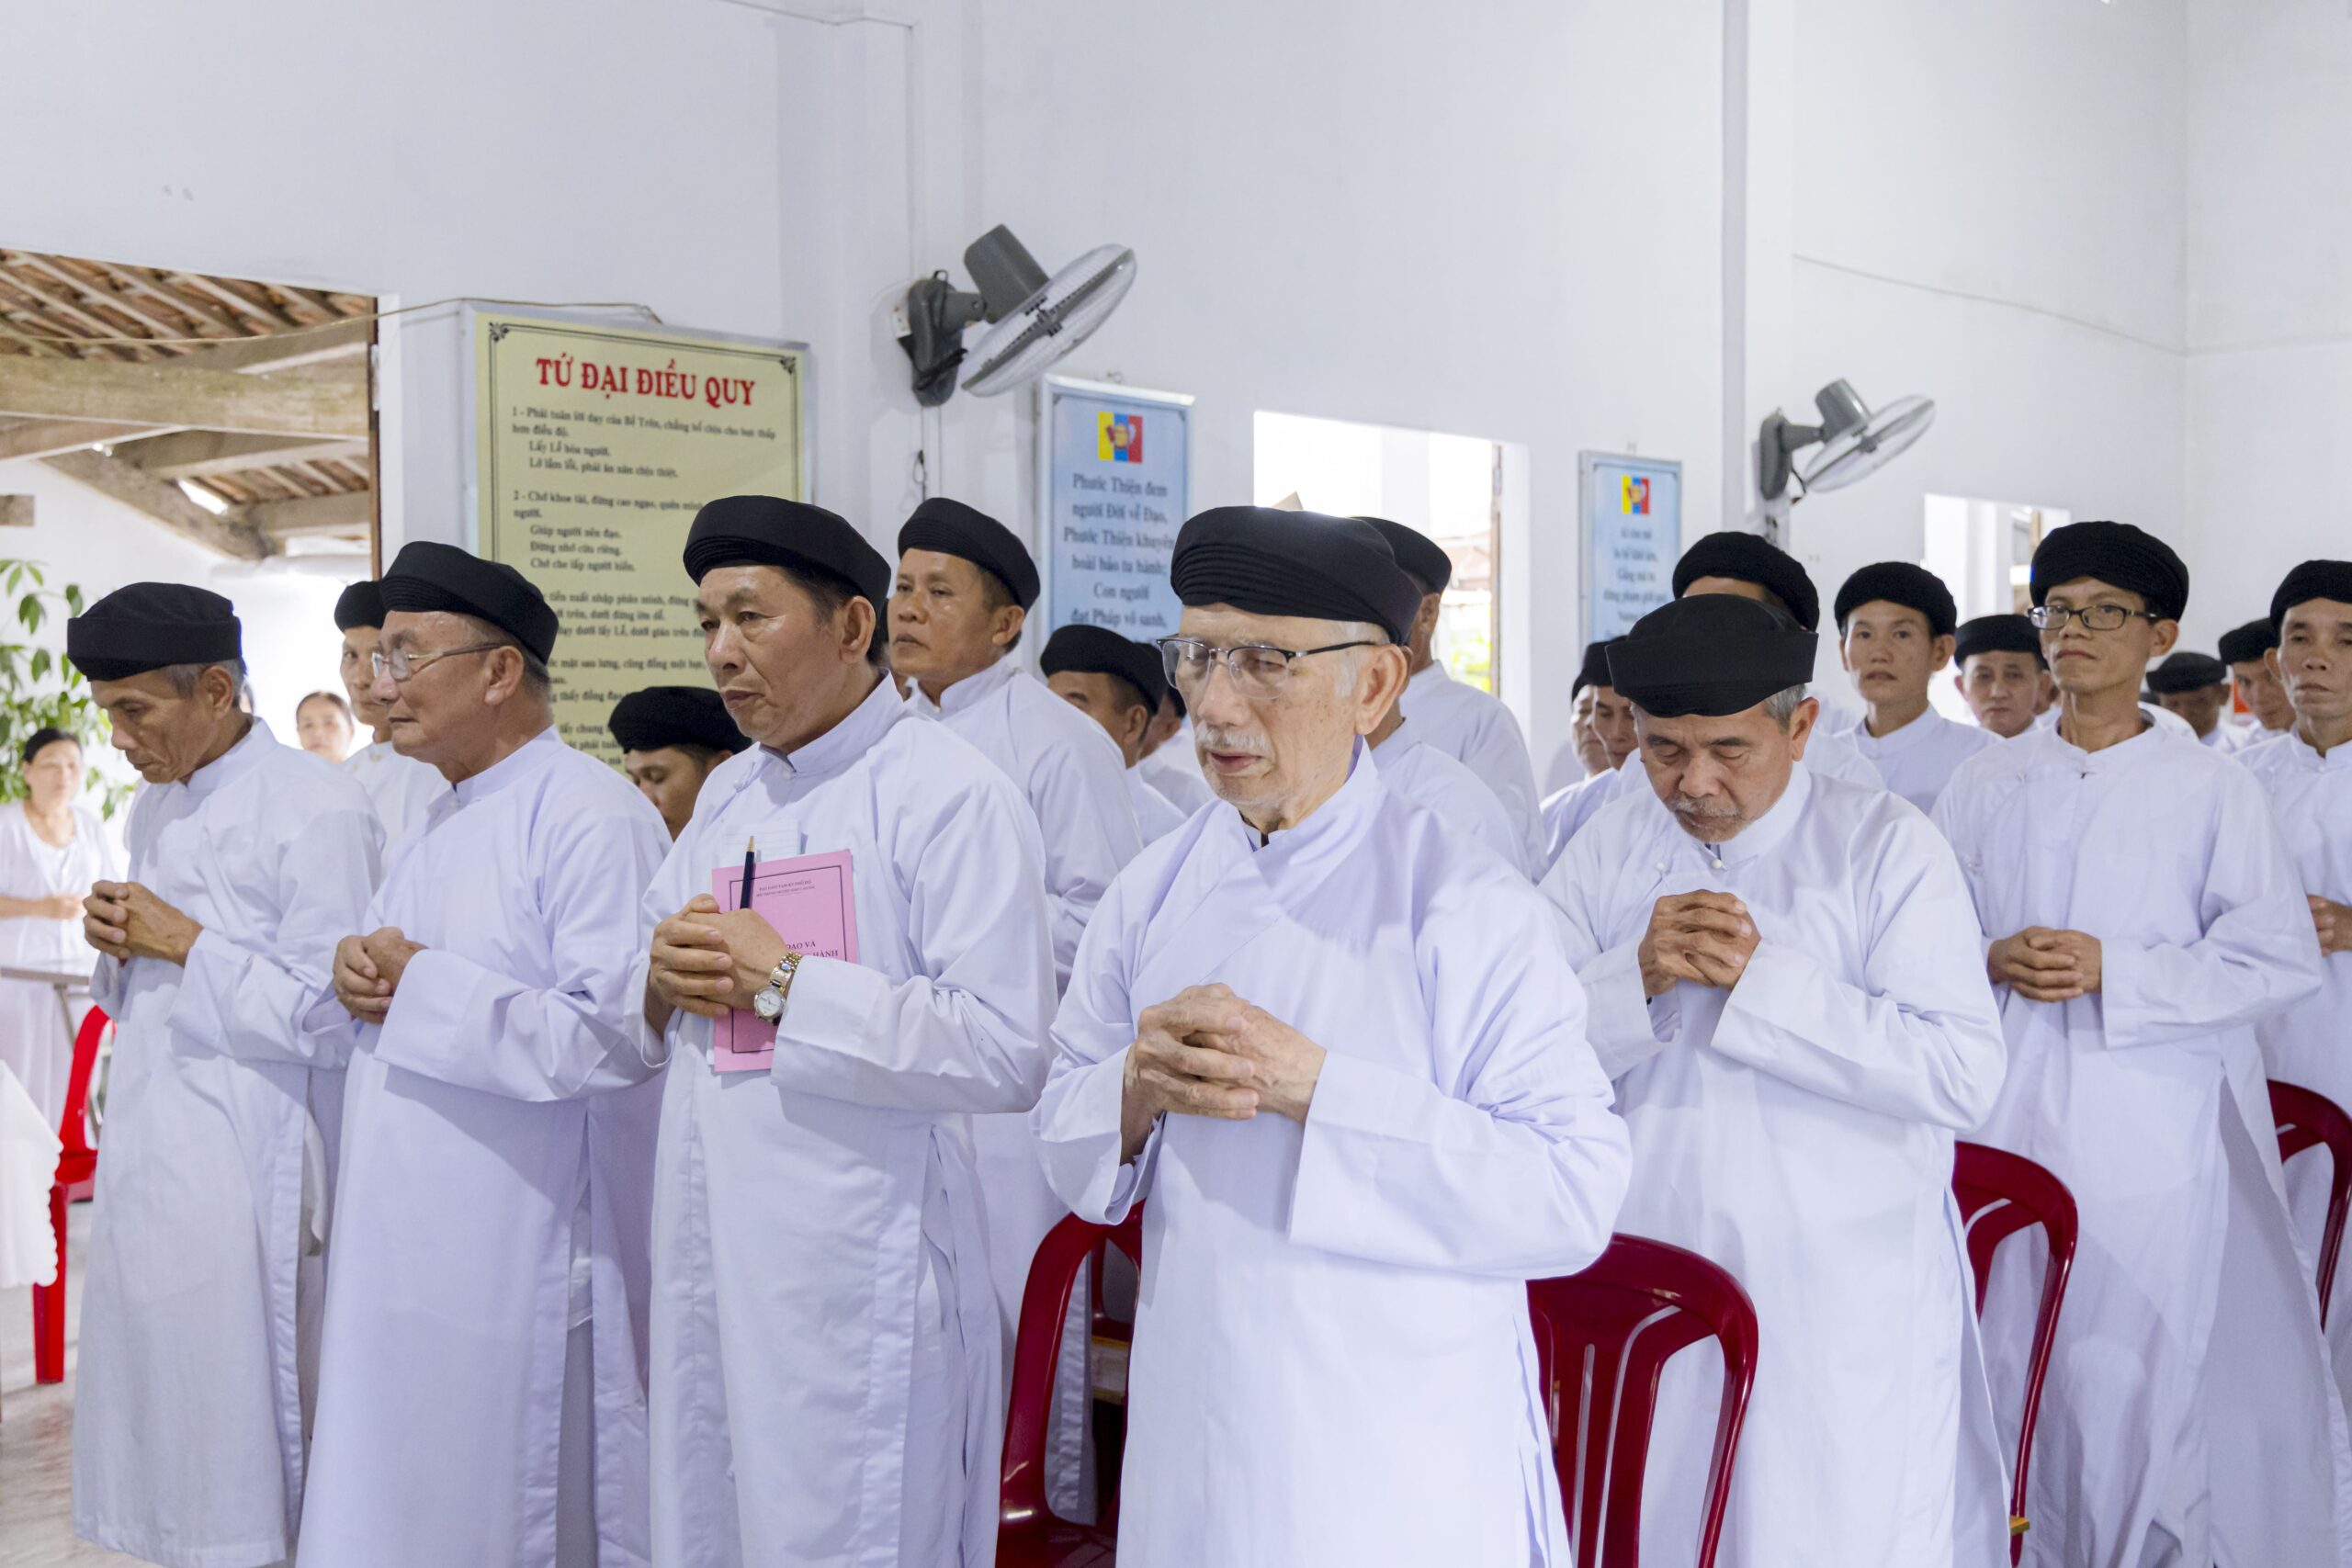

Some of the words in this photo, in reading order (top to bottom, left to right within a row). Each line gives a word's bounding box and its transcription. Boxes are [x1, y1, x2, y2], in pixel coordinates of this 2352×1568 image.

[536, 352, 574, 387] TỨ
[582, 362, 628, 400] ĐẠI
[637, 358, 697, 400] ĐIỀU
[705, 377, 755, 409] QUY
